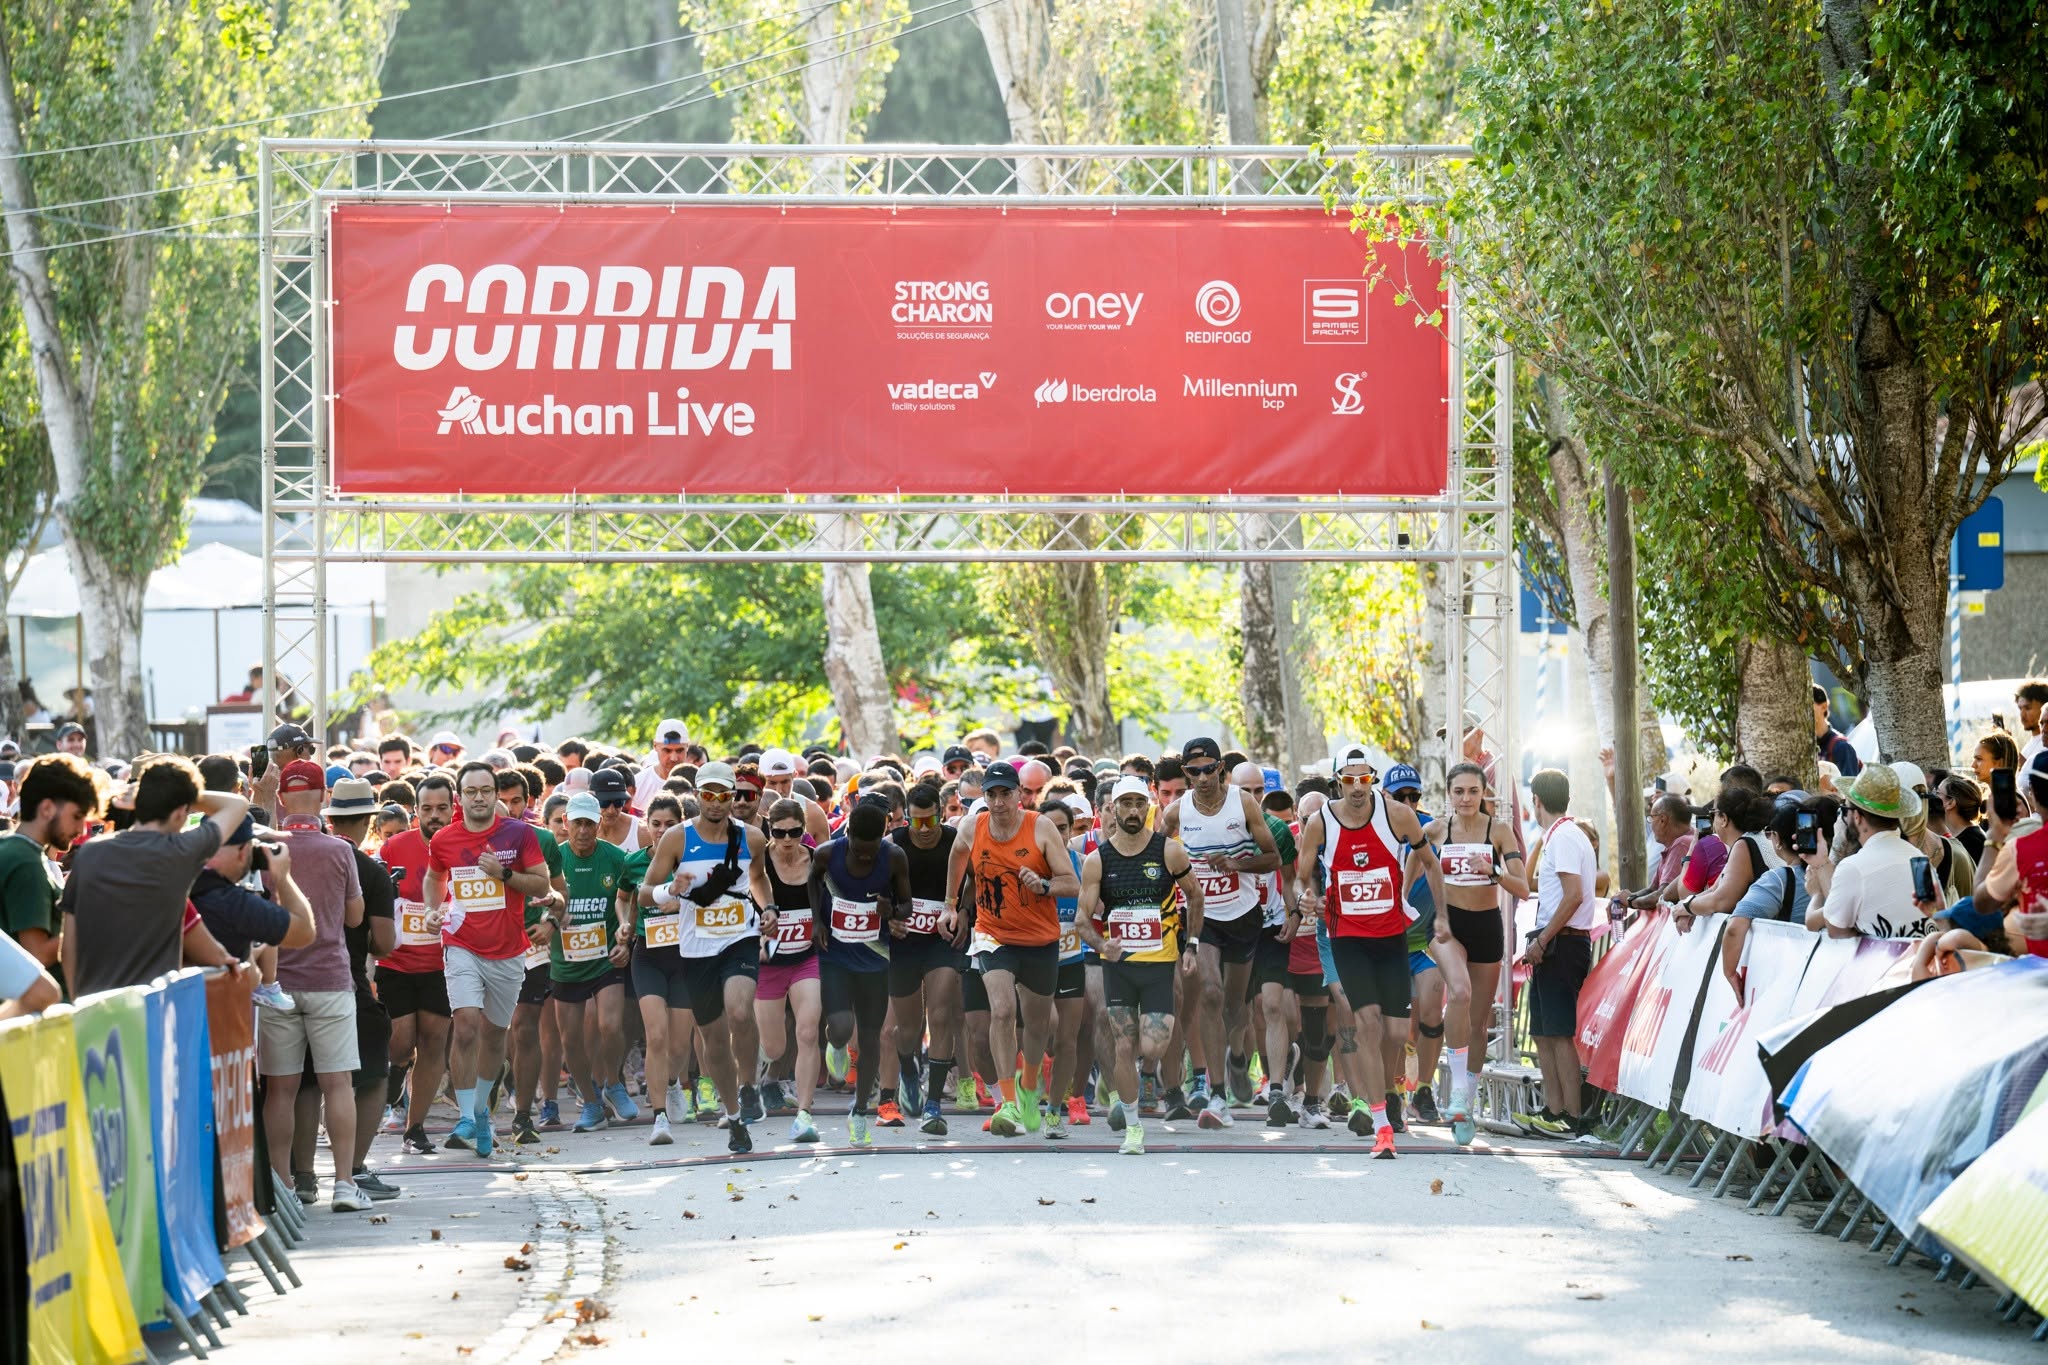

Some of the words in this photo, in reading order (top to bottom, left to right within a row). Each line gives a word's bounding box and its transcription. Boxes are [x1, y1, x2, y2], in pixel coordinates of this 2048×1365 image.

[895, 281, 989, 301] STRONG
[394, 264, 797, 371] CORRIDA
[891, 303, 992, 323] CHARON
[1045, 292, 1144, 326] oney
[897, 332, 934, 341] SOLUÇÕES
[946, 333, 990, 341] SEGURANÇA
[1185, 331, 1251, 344] REDIFOGO
[887, 379, 979, 400] vadeca
[1072, 383, 1157, 402] Iberdrola
[1183, 374, 1298, 397] Millennium
[436, 386, 634, 436] Auchan
[648, 386, 756, 436] Live
[891, 402, 918, 412] facility
[919, 403, 956, 411] solutions
[1262, 398, 1285, 411] bcp
[460, 881, 496, 898] 890
[1200, 877, 1232, 896] 742
[1350, 884, 1382, 902] 957
[566, 897, 608, 913] IMECQ
[703, 908, 739, 926] 846
[844, 915, 870, 930] 82
[655, 925, 680, 943] 65
[776, 924, 805, 941] 772
[1118, 923, 1152, 940] 183
[569, 932, 600, 950] 654
